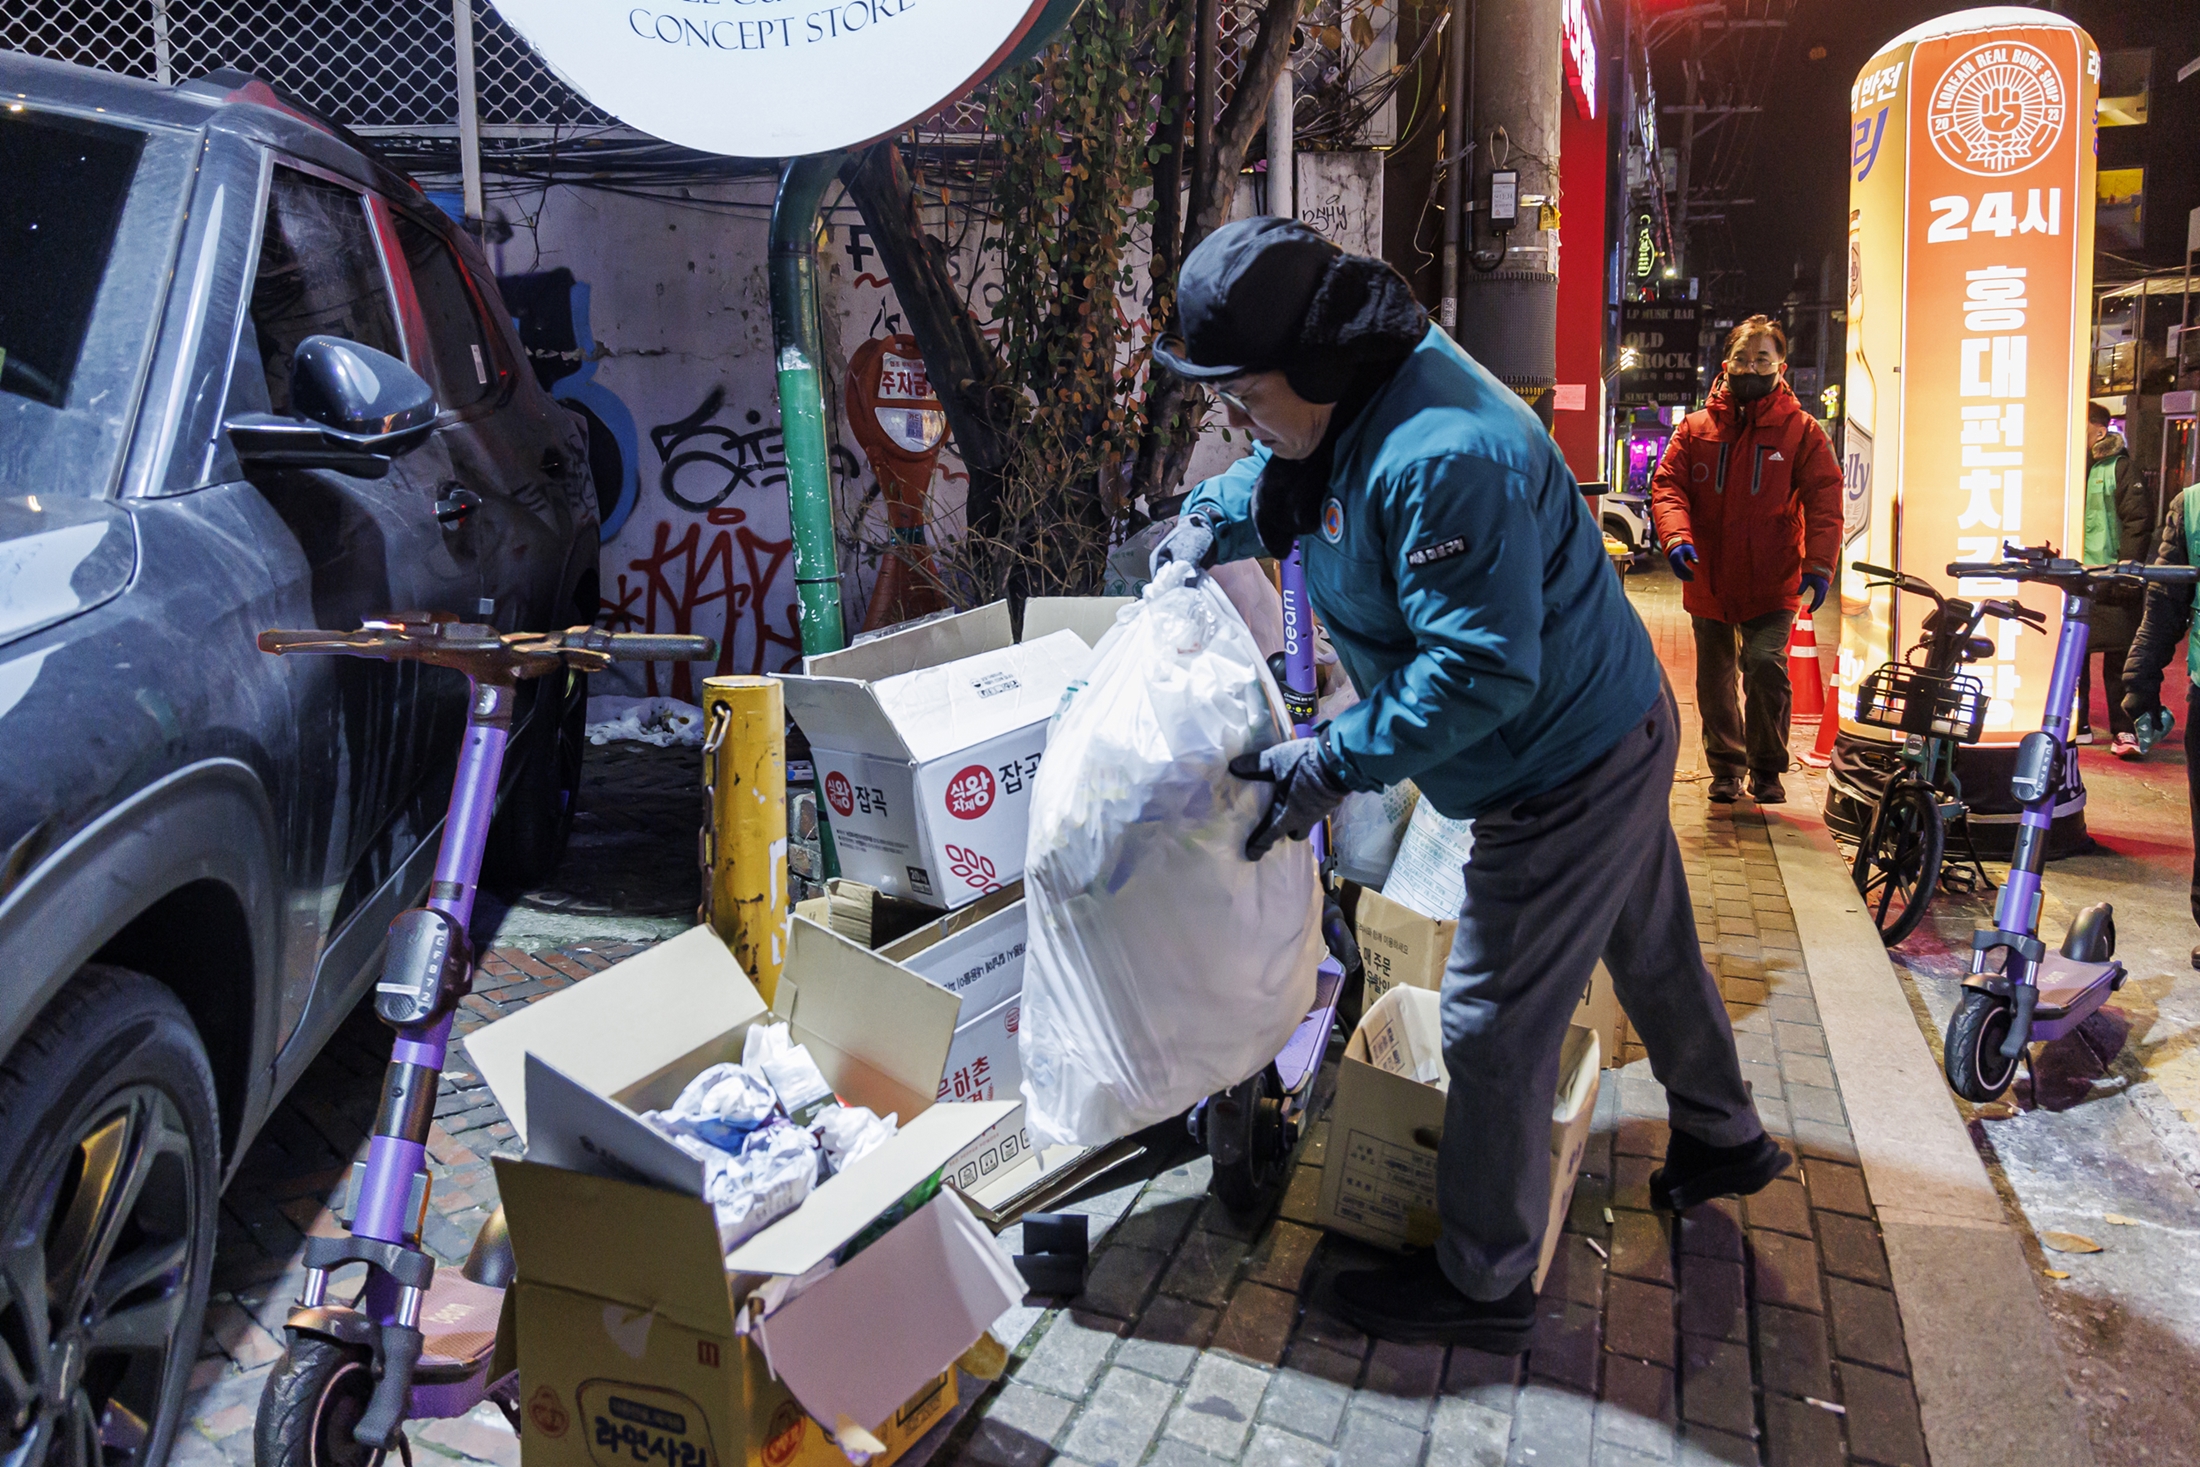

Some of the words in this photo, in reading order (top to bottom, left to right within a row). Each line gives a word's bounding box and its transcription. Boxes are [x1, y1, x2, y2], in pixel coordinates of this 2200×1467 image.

[629, 8, 795, 50] CONCEPT
[1860, 61, 1904, 109] 반전
[1936, 61, 1977, 109] KOREAN
[1975, 48, 2008, 68] REAL
[2011, 49, 2044, 74] BONE
[2039, 70, 2060, 103] SOUP
[1935, 118, 1949, 131] 20
[2048, 108, 2060, 121] 23
[1850, 106, 1889, 182] 리
[1927, 187, 2061, 244] 24시
[1627, 308, 1640, 320] LP
[1642, 308, 1672, 320] MUSIC
[1674, 308, 1695, 320] BAR
[1625, 331, 1665, 348] OLD
[1636, 353, 1692, 369] ROCK
[881, 370, 934, 397] 주차금
[1283, 589, 1299, 656] beam
[854, 785, 888, 818] 잡곡
[1373, 951, 1391, 978] 주문
[595, 1415, 708, 1467] 라면사리
